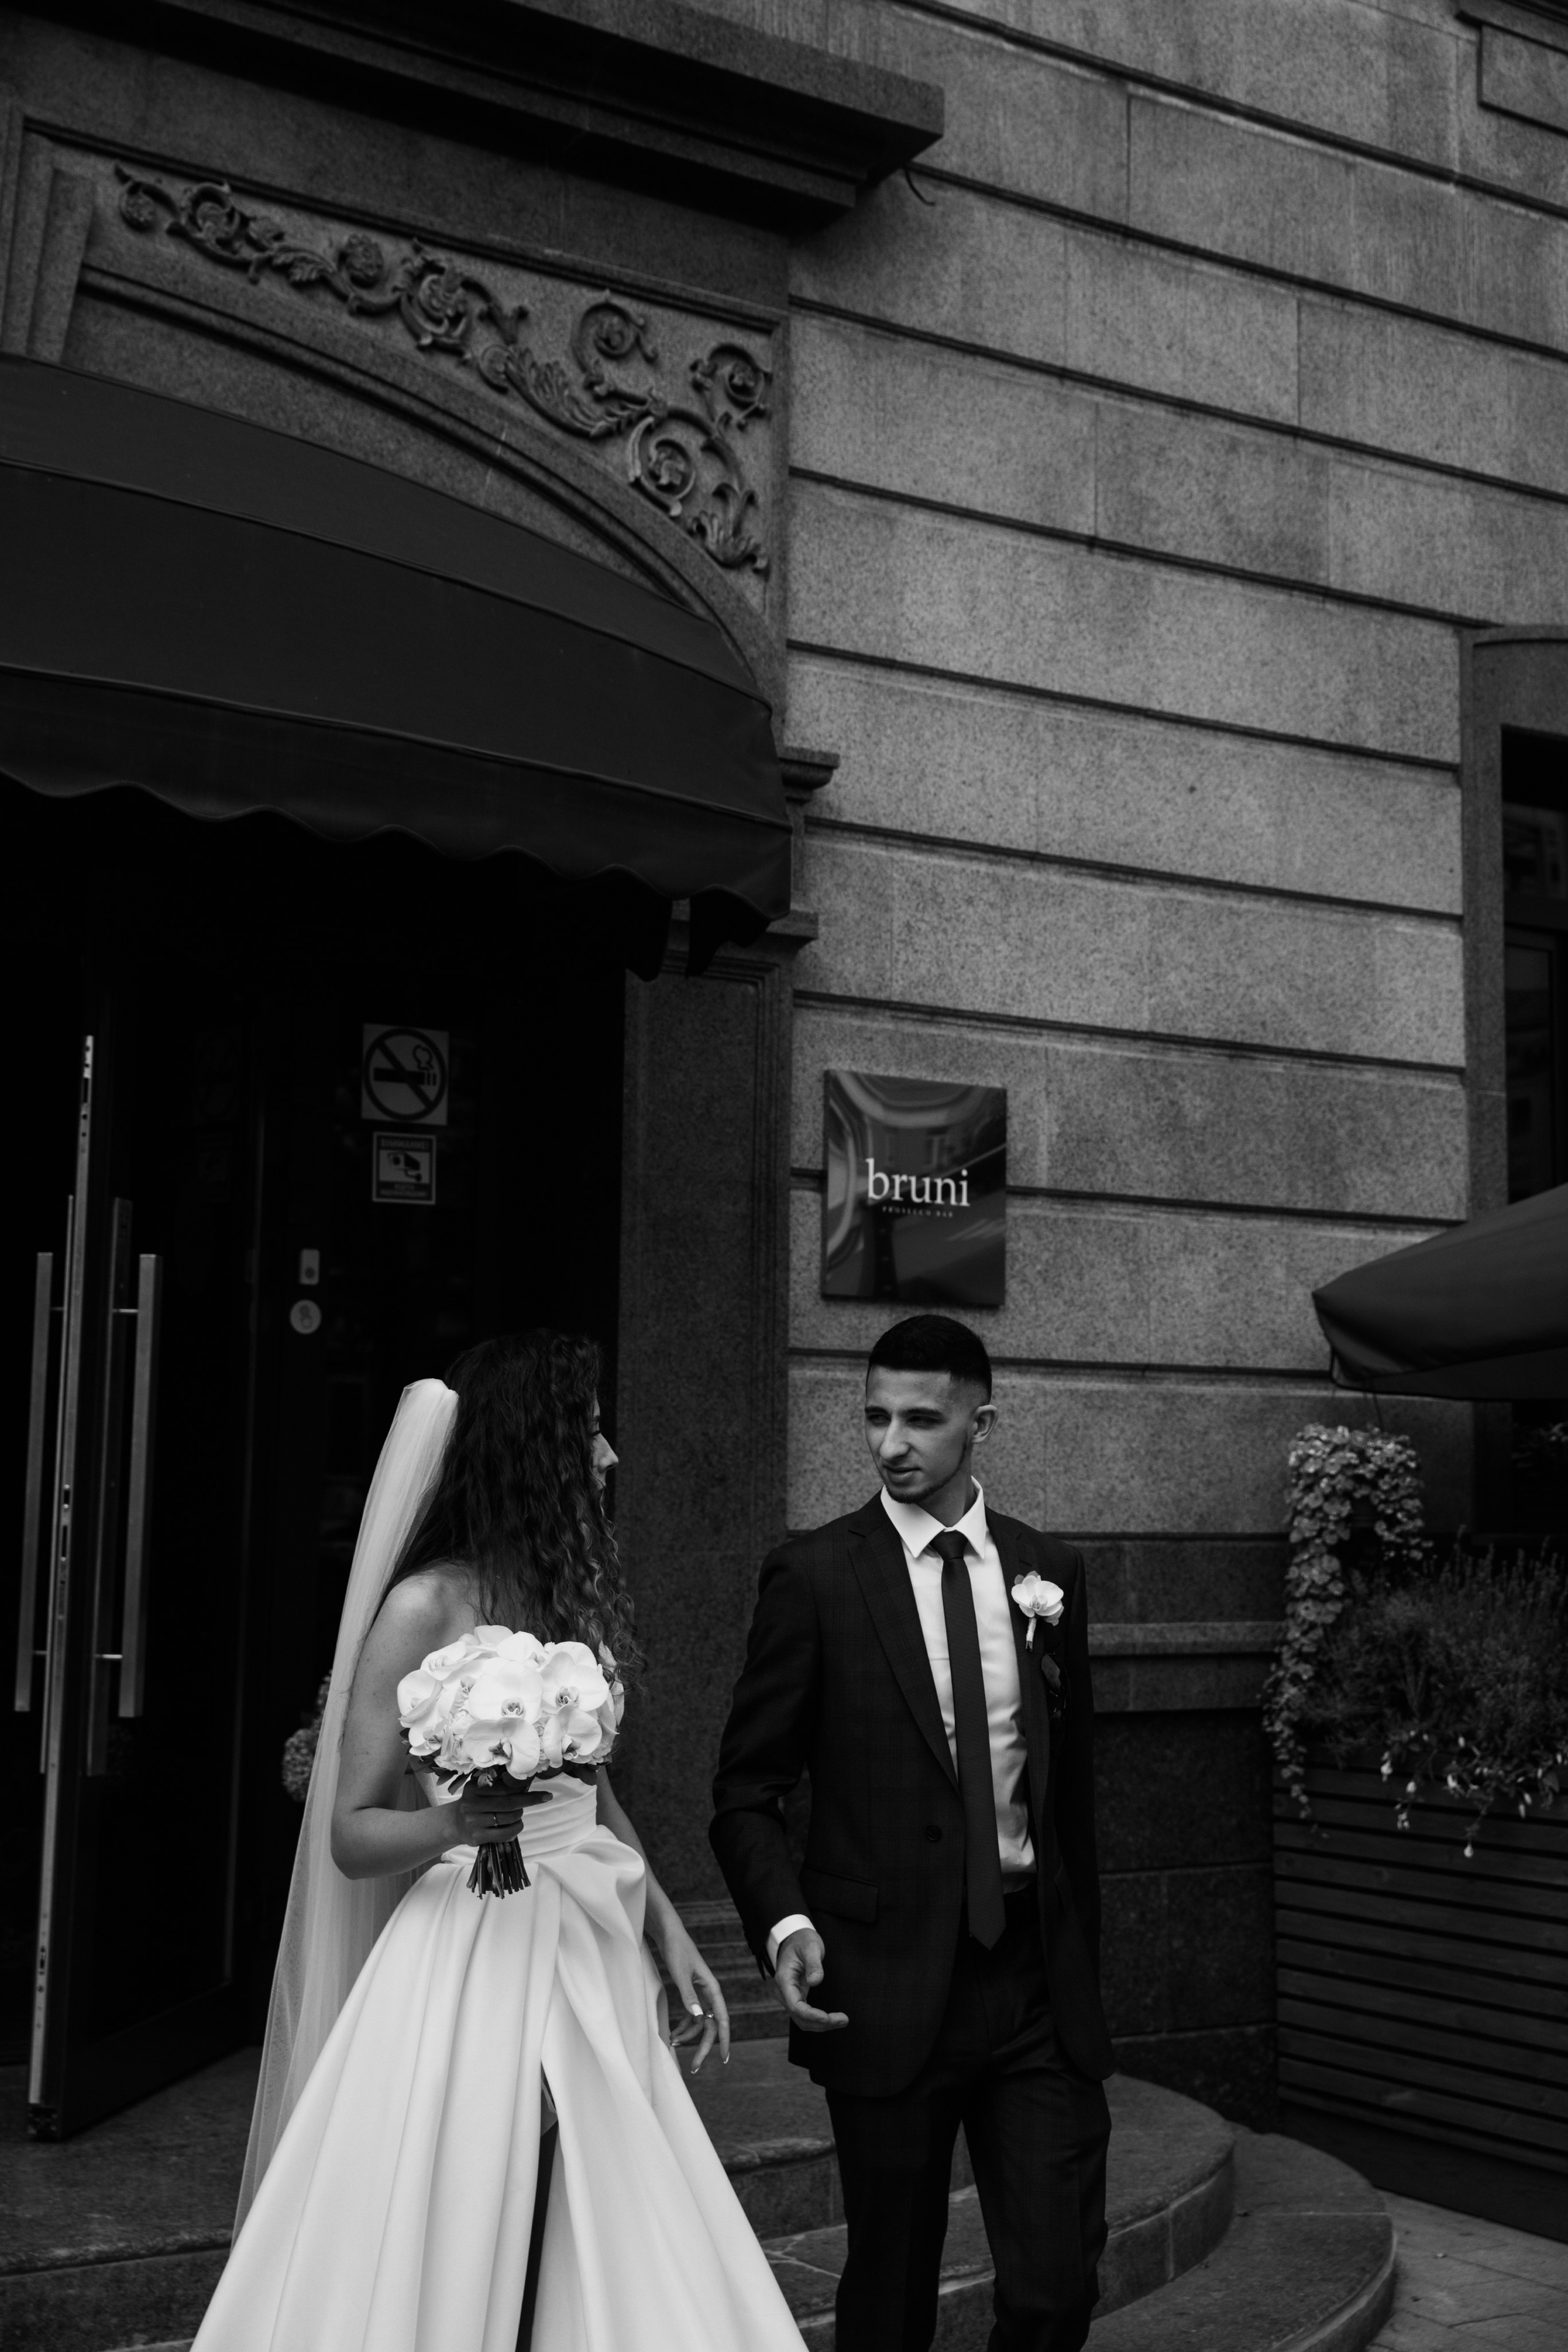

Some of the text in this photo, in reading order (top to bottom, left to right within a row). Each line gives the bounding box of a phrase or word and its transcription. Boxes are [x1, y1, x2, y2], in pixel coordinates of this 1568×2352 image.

[865, 1157, 971, 1207] bruni
[881, 1205, 953, 1218] PROSECCO BAR
